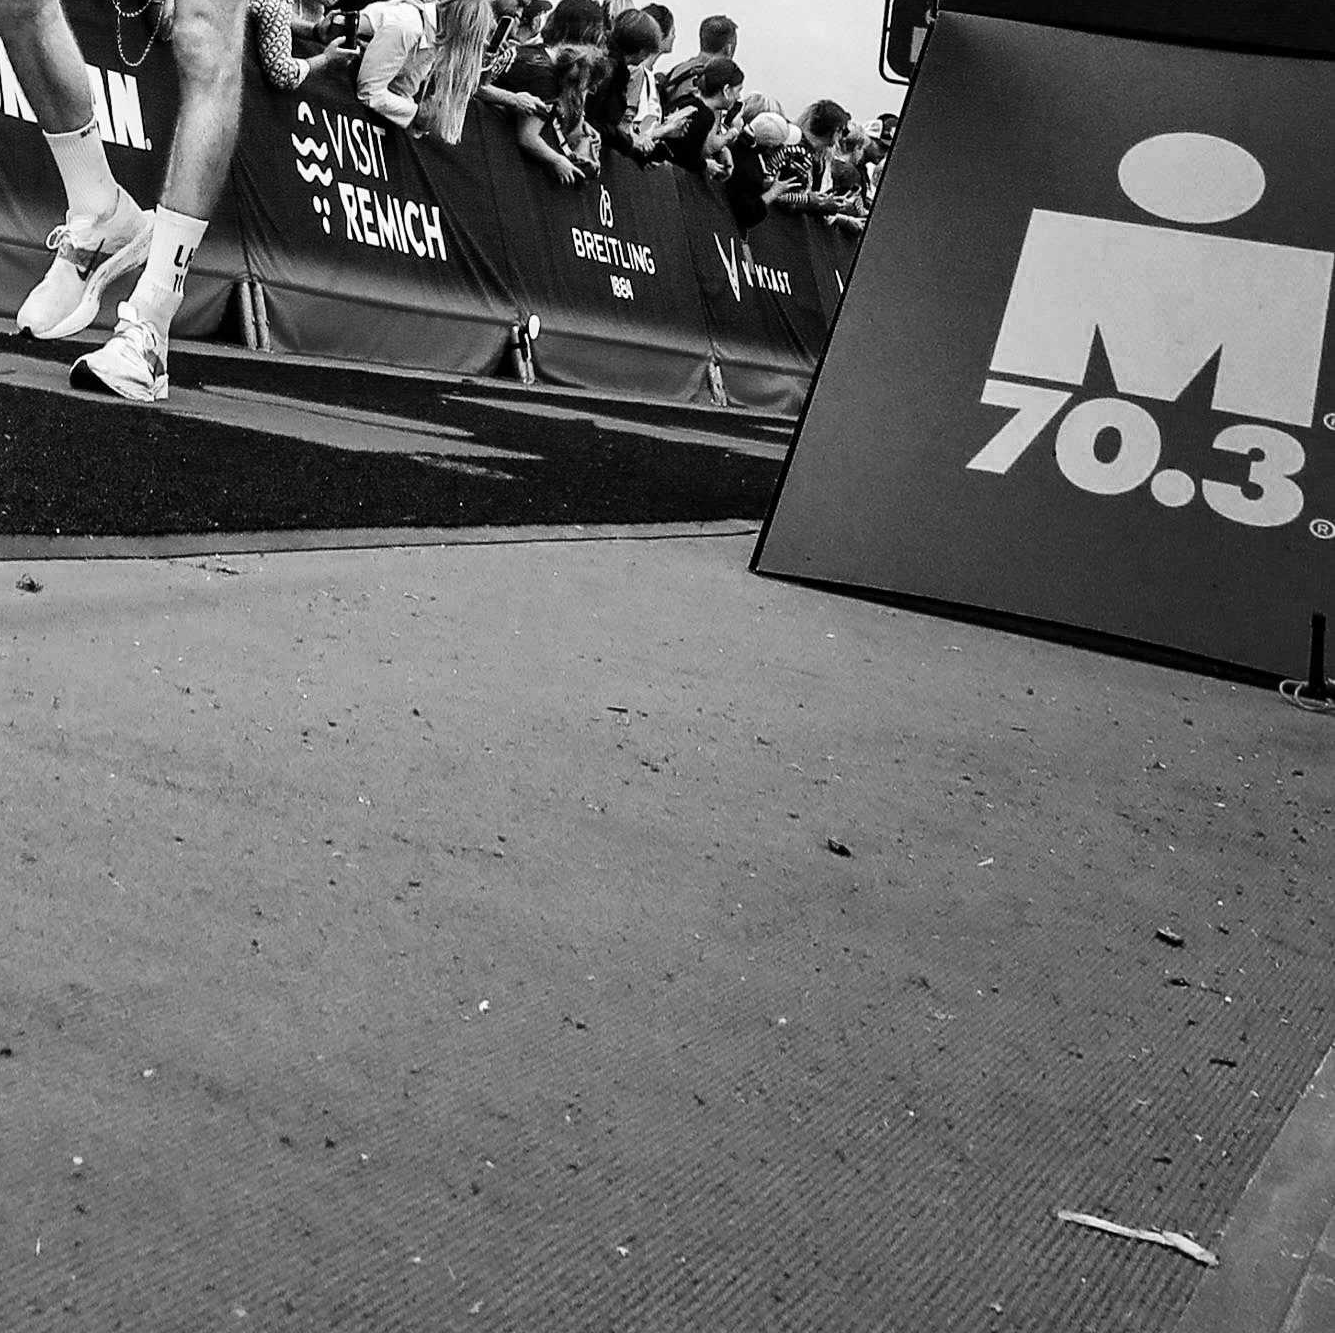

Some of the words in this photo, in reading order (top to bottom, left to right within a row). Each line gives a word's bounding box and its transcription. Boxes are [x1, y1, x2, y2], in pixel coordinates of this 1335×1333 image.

[322, 108, 389, 182] VISIT
[338, 181, 447, 262] REMICH
[571, 227, 656, 275] BREITLING
[966, 379, 1306, 527] 70.3
